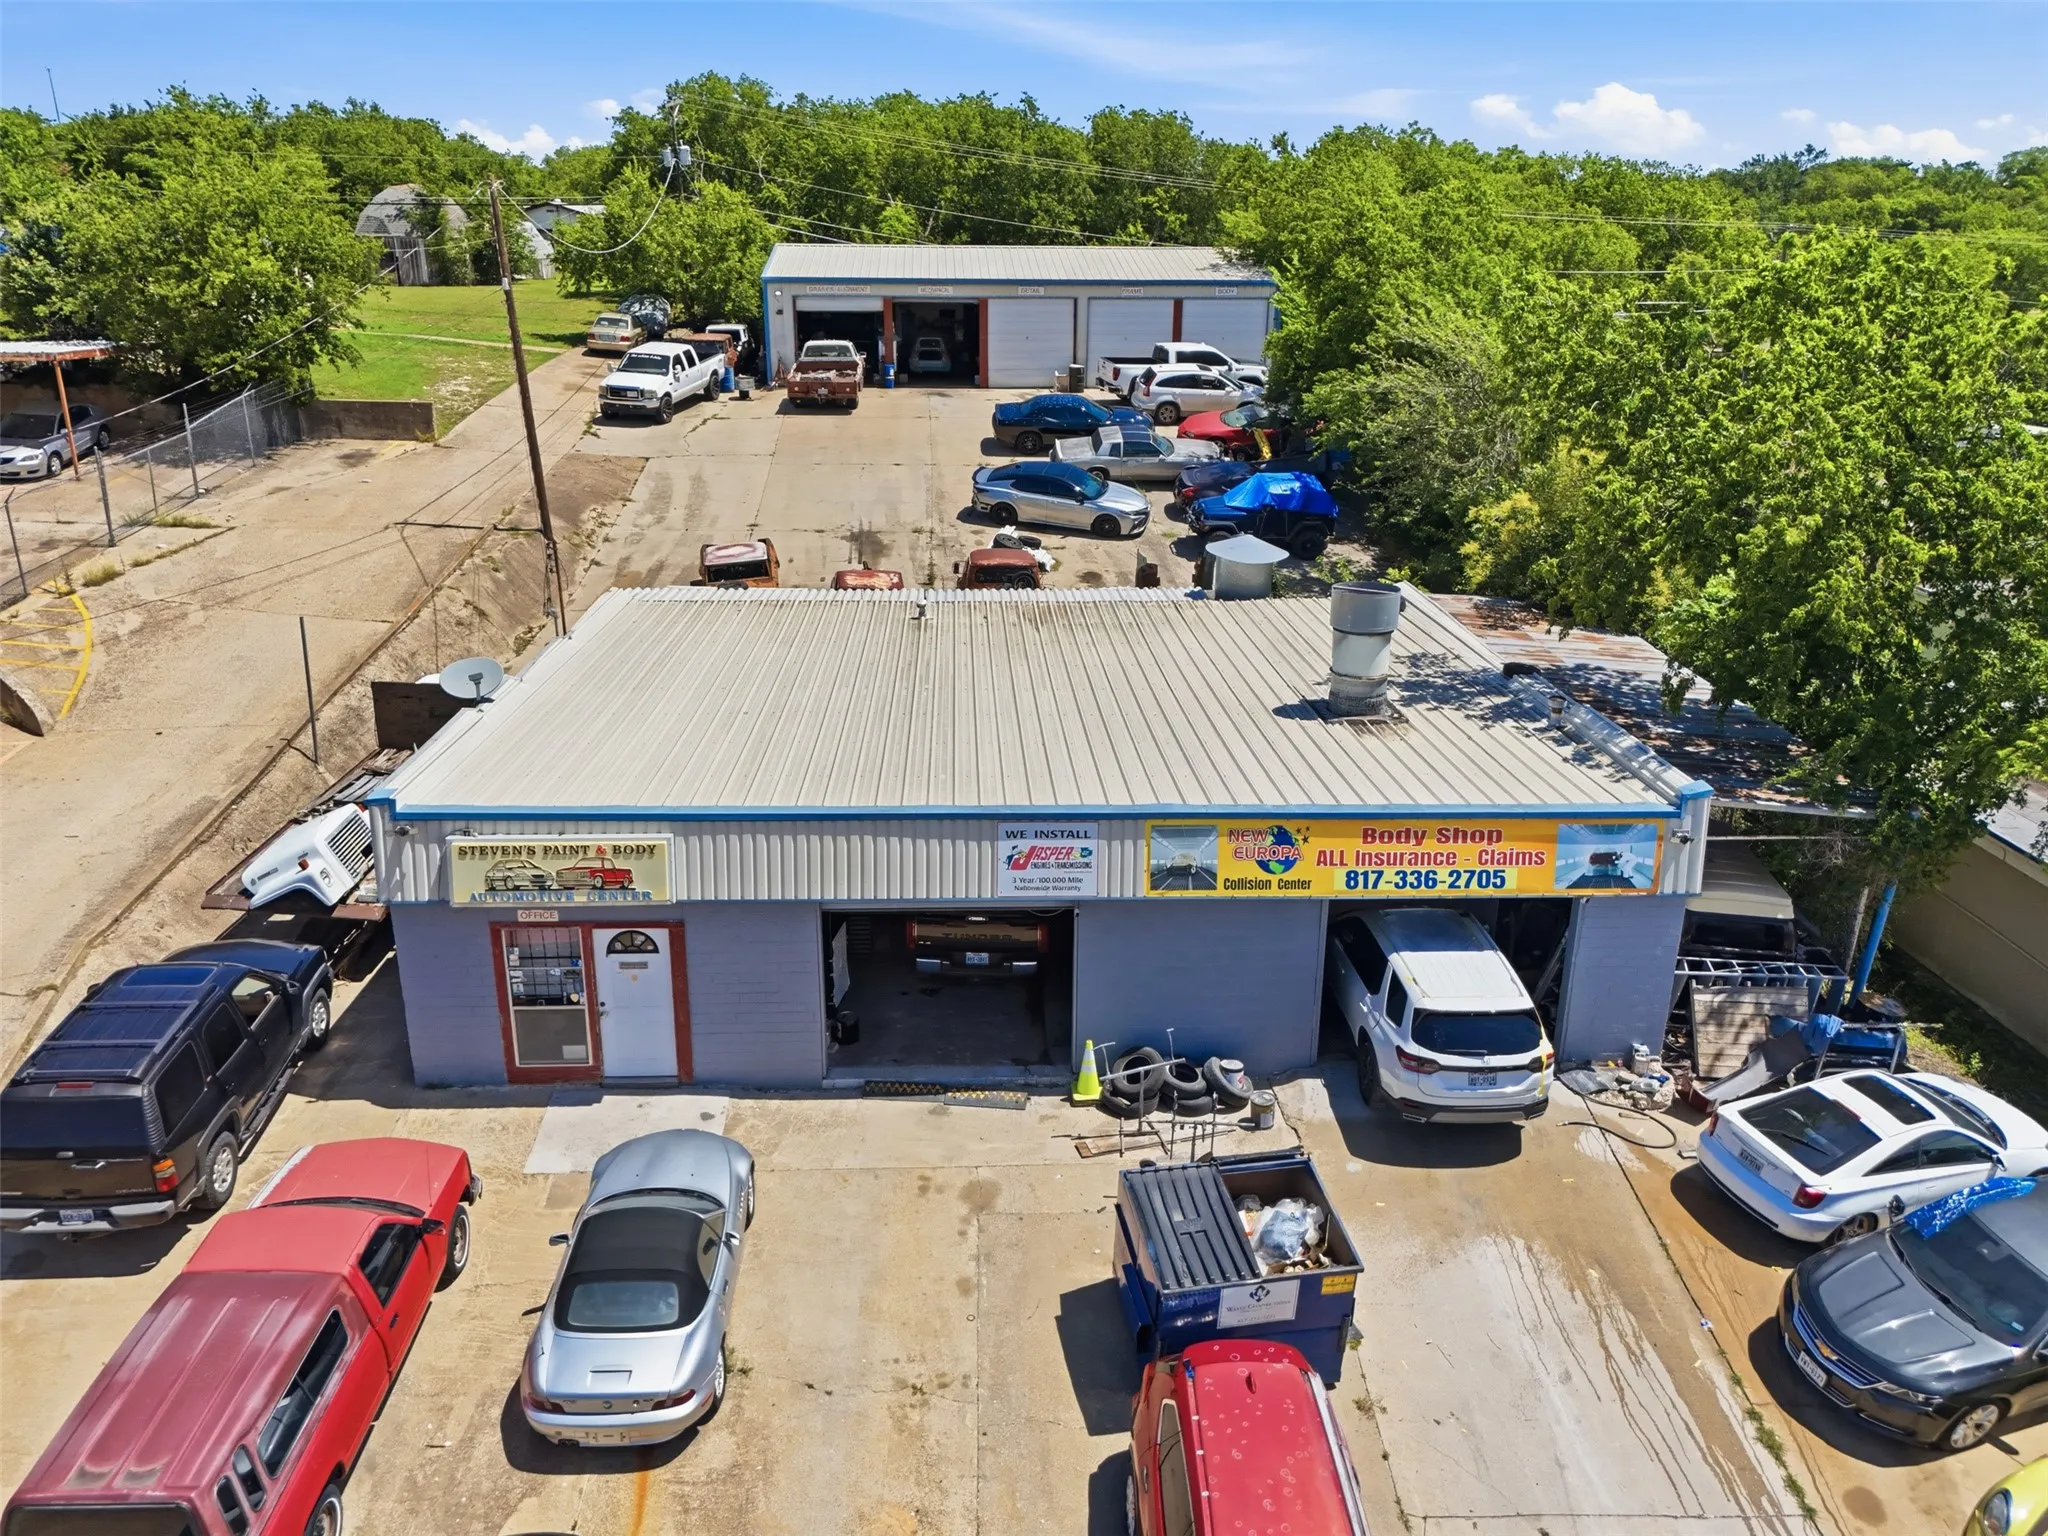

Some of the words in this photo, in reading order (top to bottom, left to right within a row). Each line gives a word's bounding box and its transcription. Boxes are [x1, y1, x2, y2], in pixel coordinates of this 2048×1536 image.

[1005, 830, 1027, 839] WE
[1034, 830, 1091, 839] INSTALL
[1227, 829, 1269, 843] NEW
[1361, 827, 1427, 846] Body
[1436, 827, 1503, 846] Shop
[458, 845, 536, 857] STEVEN'S
[543, 845, 590, 857] PAINT
[595, 844, 607, 856] &
[612, 844, 656, 856] BODY
[1233, 845, 1304, 861] EUROPA
[1316, 849, 1348, 866] ALL
[1355, 849, 1457, 866] Insurance
[1477, 848, 1546, 866] Claims
[1010, 845, 1075, 870] JASPER
[1031, 861, 1051, 869] ENGINES
[1054, 861, 1092, 869] TRANSMISSIONS
[1067, 876, 1084, 884] Mile
[1224, 877, 1272, 890] Collision
[1278, 878, 1312, 890] Center
[1345, 869, 1506, 889] 817-336-2705
[469, 891, 576, 902] AUTOMOTIVE
[587, 890, 654, 901] CENTER
[520, 911, 556, 920] OFFICE
